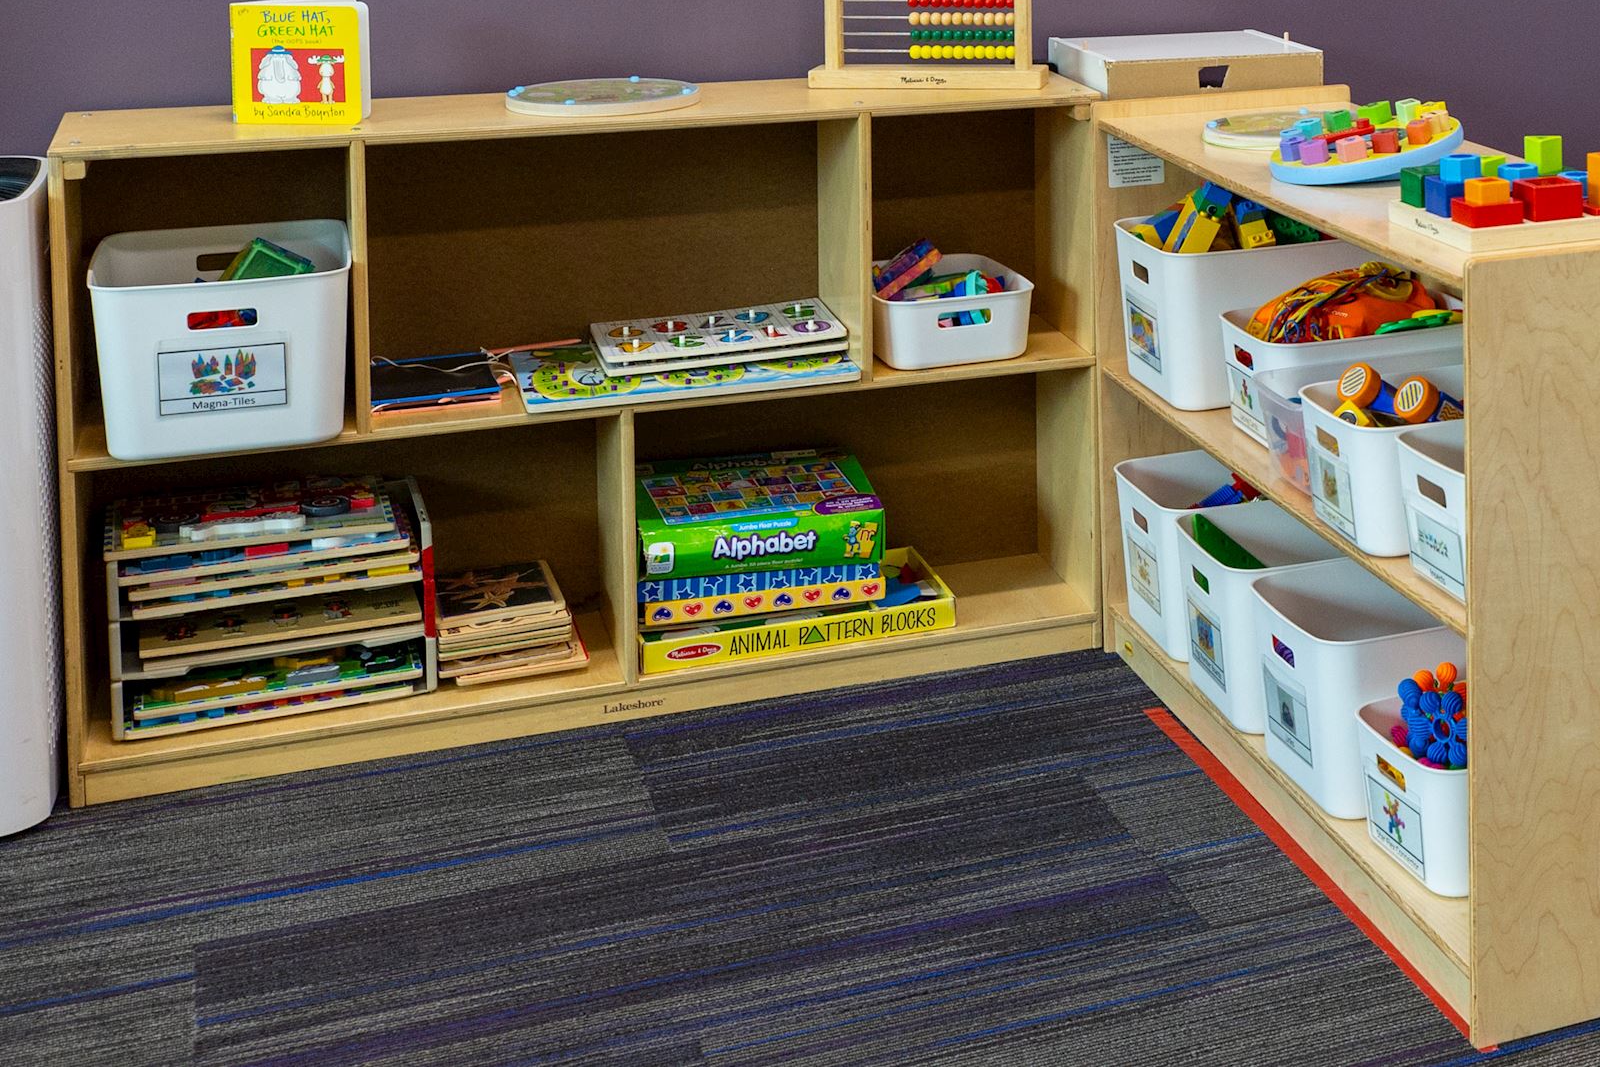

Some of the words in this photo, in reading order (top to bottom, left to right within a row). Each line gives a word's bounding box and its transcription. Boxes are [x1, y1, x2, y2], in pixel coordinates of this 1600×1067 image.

[261, 10, 296, 23] BLUE
[301, 10, 331, 23] HAT,
[257, 24, 305, 37] GREEN
[310, 24, 336, 37] HAT
[254, 107, 265, 119] by
[267, 106, 301, 117] Sandra
[304, 107, 345, 120] Boynton
[192, 396, 256, 410] Magna-Tiles
[692, 457, 788, 471] Alphabet
[773, 519, 792, 528] Puzzle
[713, 531, 817, 560] Alphabet
[729, 628, 790, 656] ANIMAL
[881, 608, 936, 634] BLOCKS
[604, 697, 664, 714] Lakeshore
